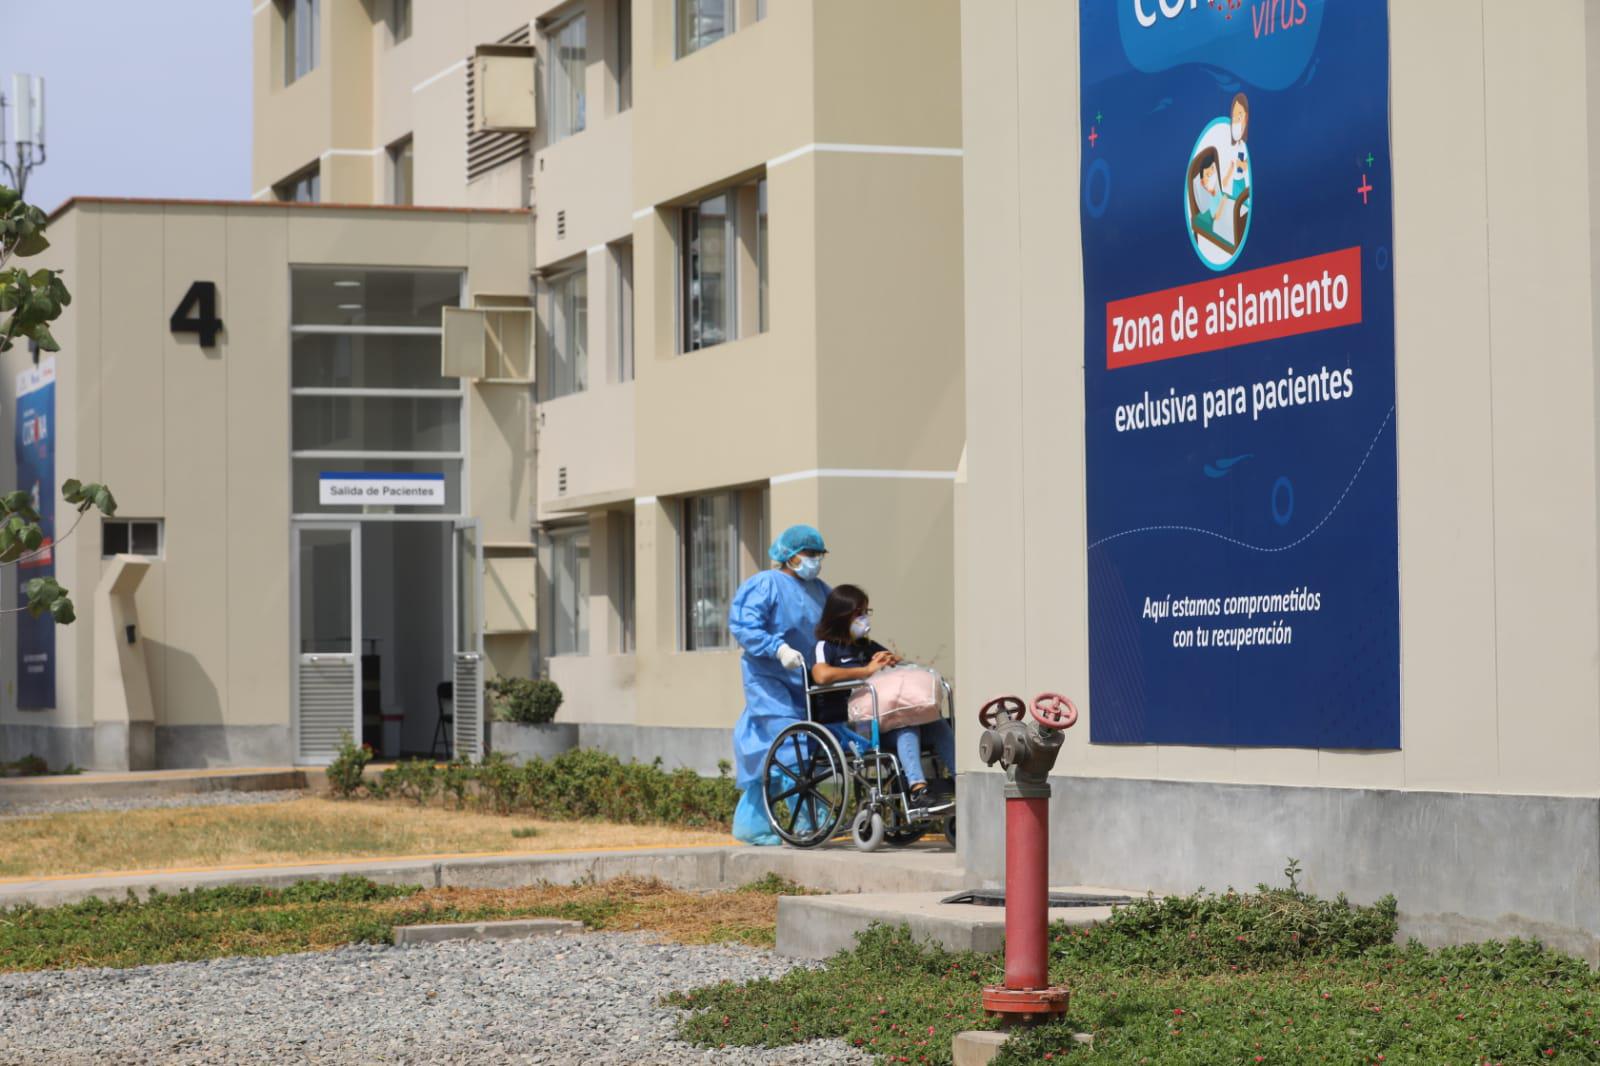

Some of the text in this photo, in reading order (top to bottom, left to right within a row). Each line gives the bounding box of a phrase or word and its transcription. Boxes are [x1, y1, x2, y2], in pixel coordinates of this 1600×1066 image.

[169, 281, 224, 348] 4
[1112, 269, 1349, 353] Zona de aislamiento
[1115, 366, 1353, 432] exclusiva para pacientes
[330, 486, 434, 496] Salida de Pacientes
[1142, 586, 1321, 623] Aquí estamos comprometidos
[1173, 619, 1293, 651] con tu recuperación
